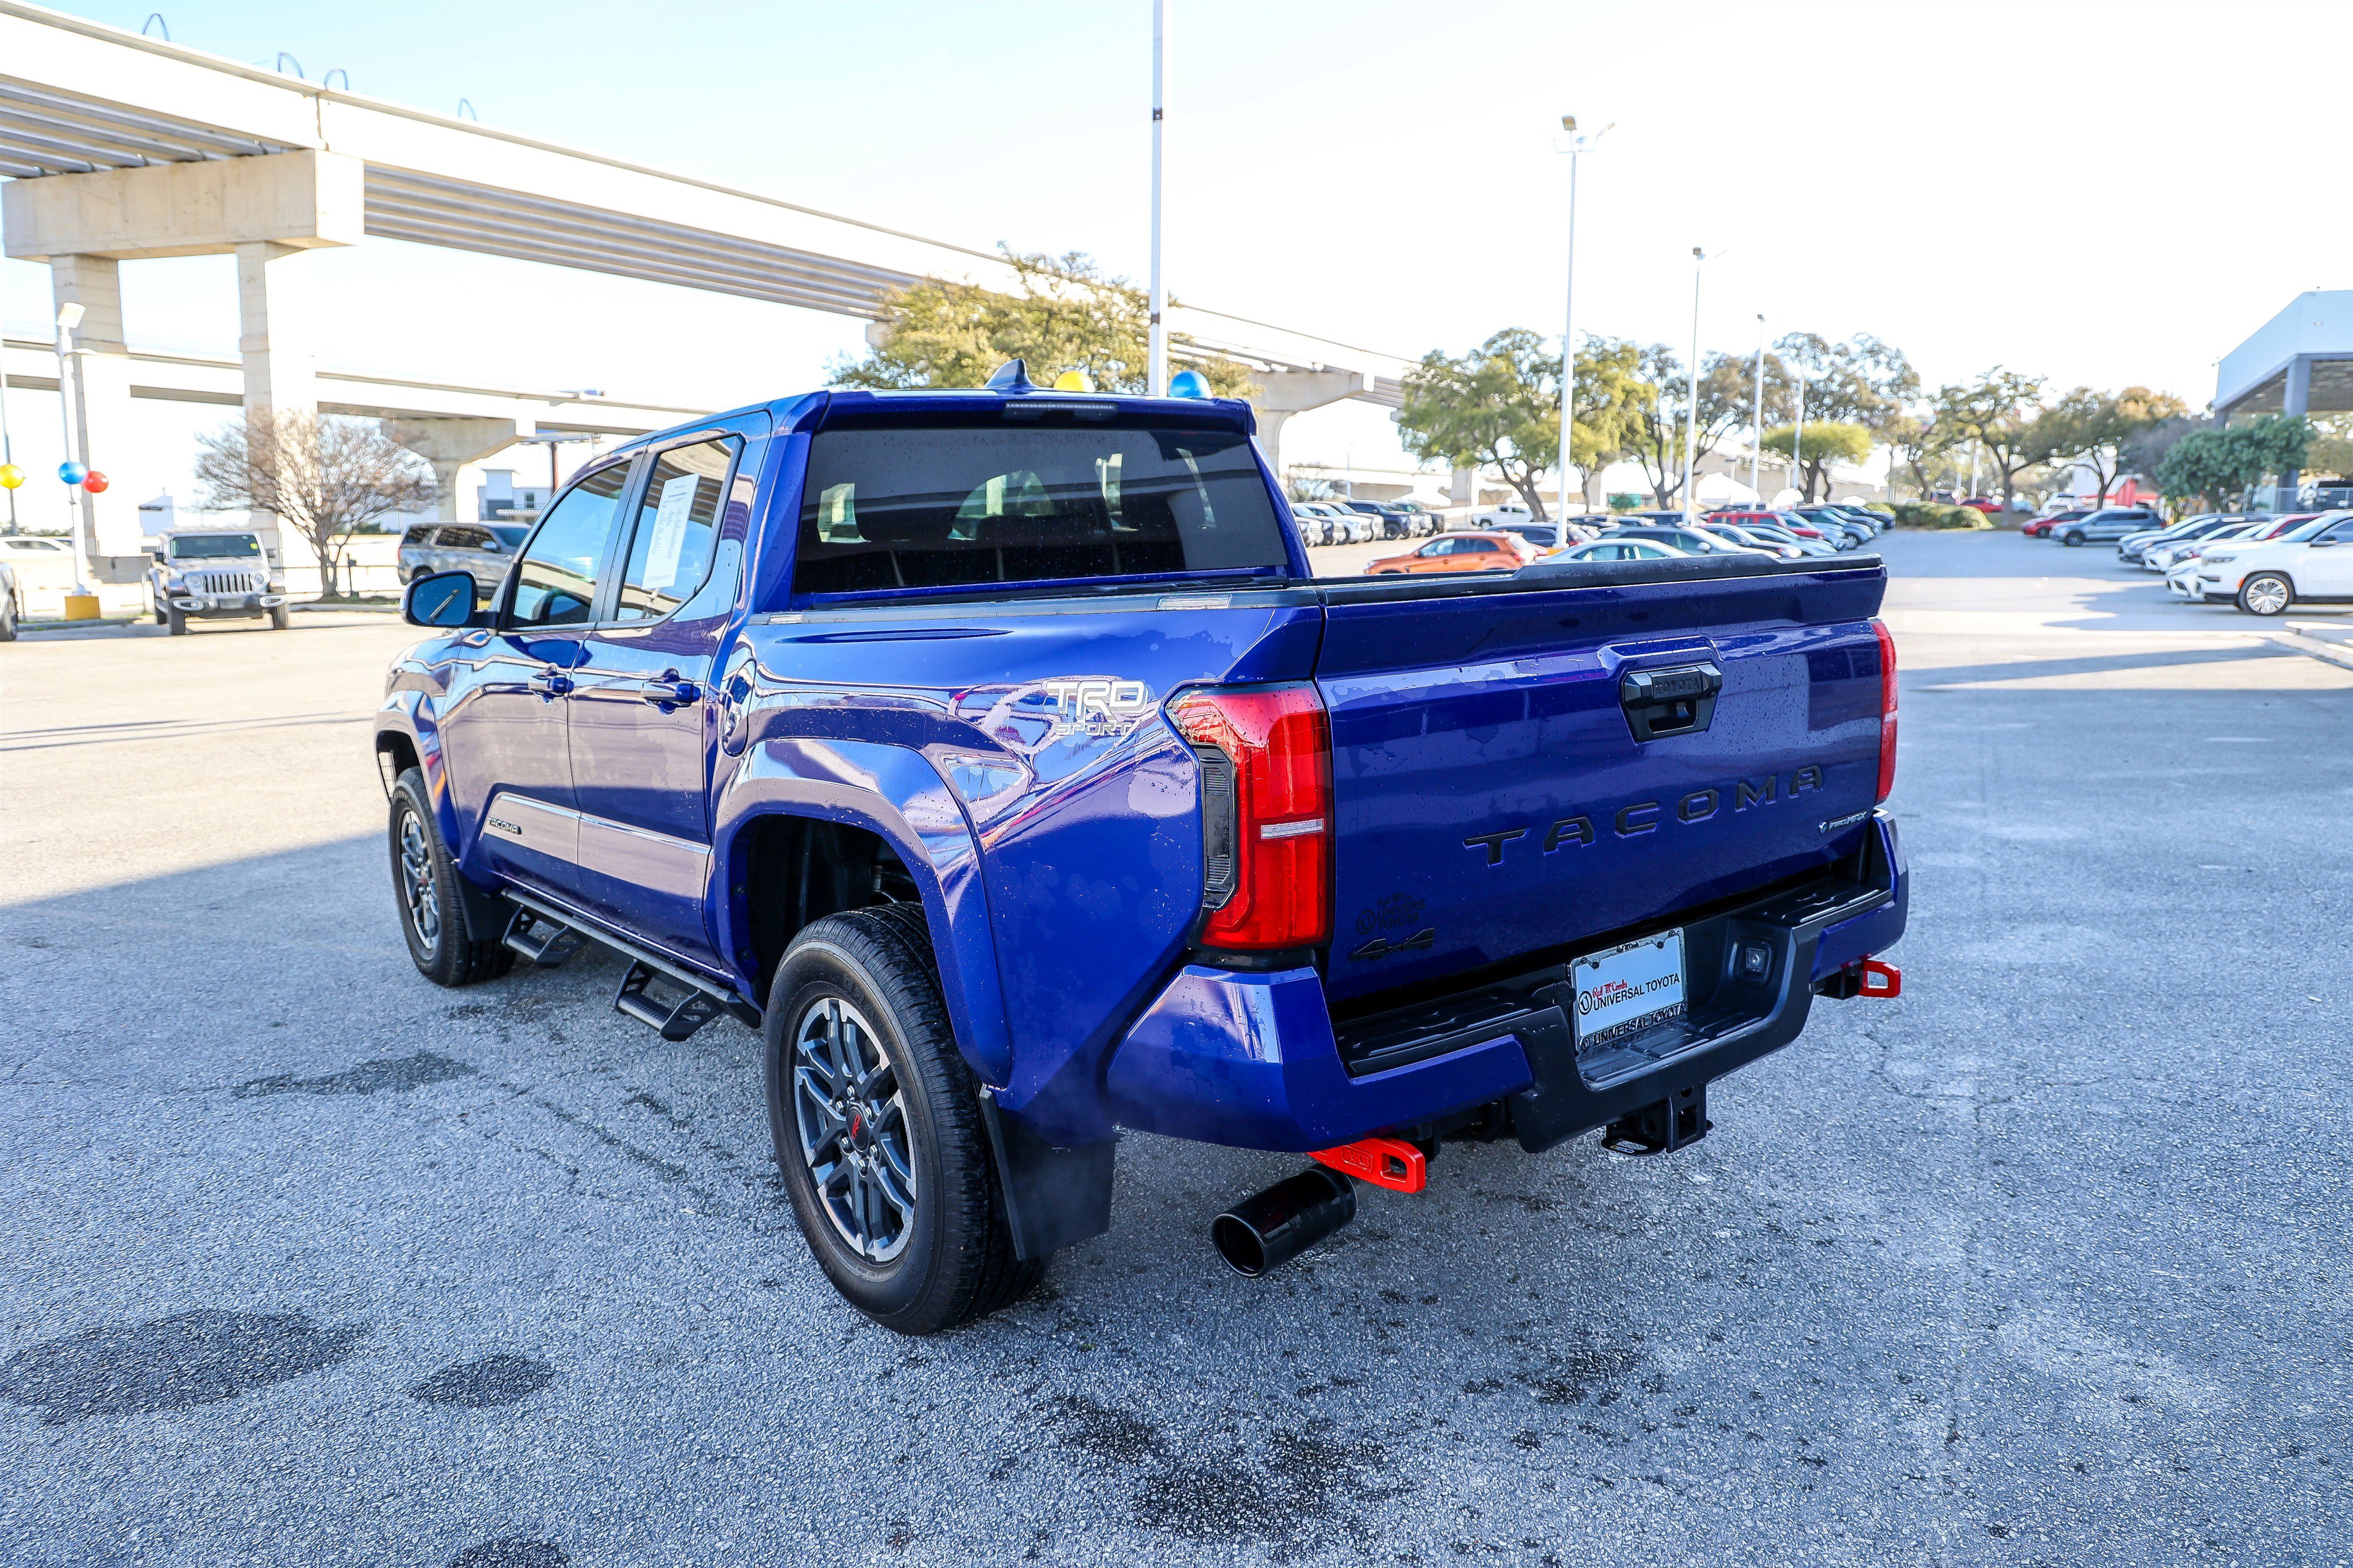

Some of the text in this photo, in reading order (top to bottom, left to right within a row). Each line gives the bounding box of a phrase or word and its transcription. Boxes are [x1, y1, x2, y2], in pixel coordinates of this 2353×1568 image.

[1656, 677, 1701, 695] TOYOTA
[1044, 680, 1148, 723] TRD
[1055, 722, 1132, 736] SPORT
[487, 817, 519, 835] TACOMA
[1464, 766, 1824, 867] TACOMA
[1378, 912, 1419, 930] TOYOTA
[1592, 979, 1628, 1000] Red McCombs
[1593, 973, 1680, 1011] UNIVERSAL TOYOTA
[1593, 1003, 1685, 1046] UNIVERSAL TOYOTA
[1344, 1149, 1371, 1168] ARB
